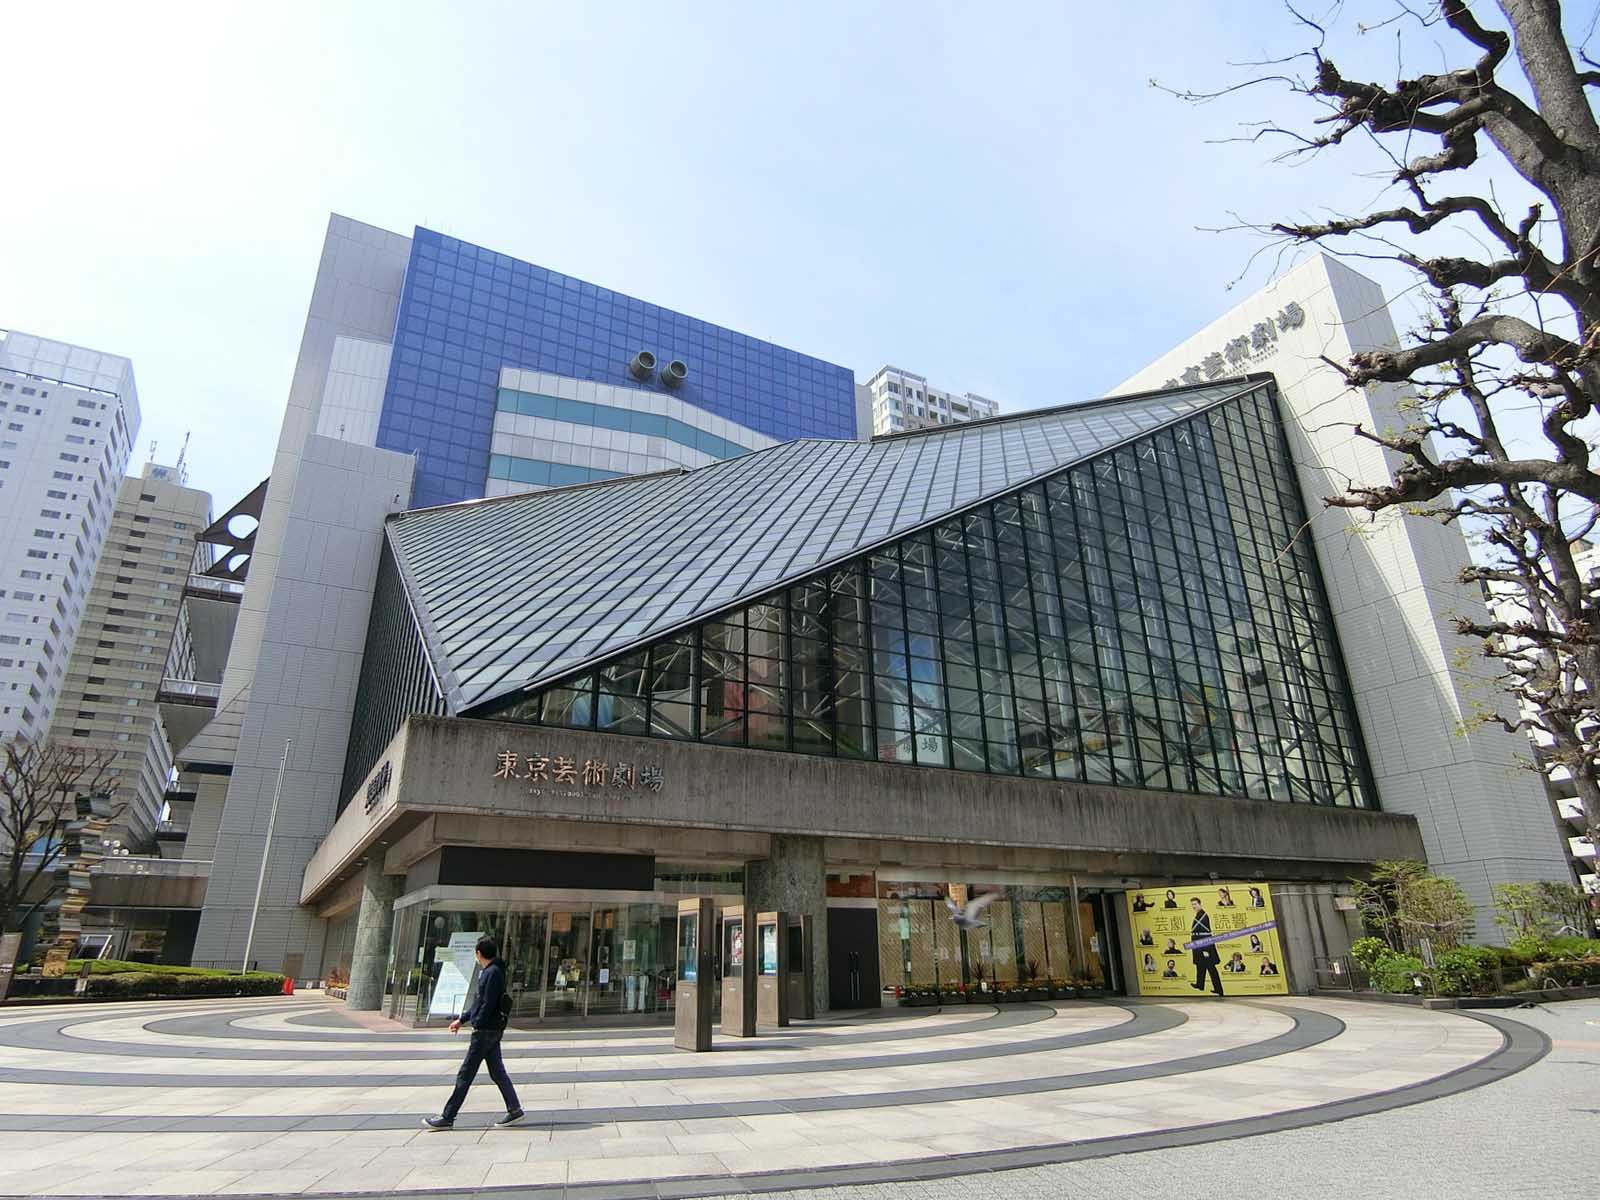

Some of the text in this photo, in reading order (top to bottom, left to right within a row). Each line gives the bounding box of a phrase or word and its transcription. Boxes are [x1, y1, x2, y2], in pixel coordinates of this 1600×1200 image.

[493, 750, 665, 793] 東京芸術劇場
